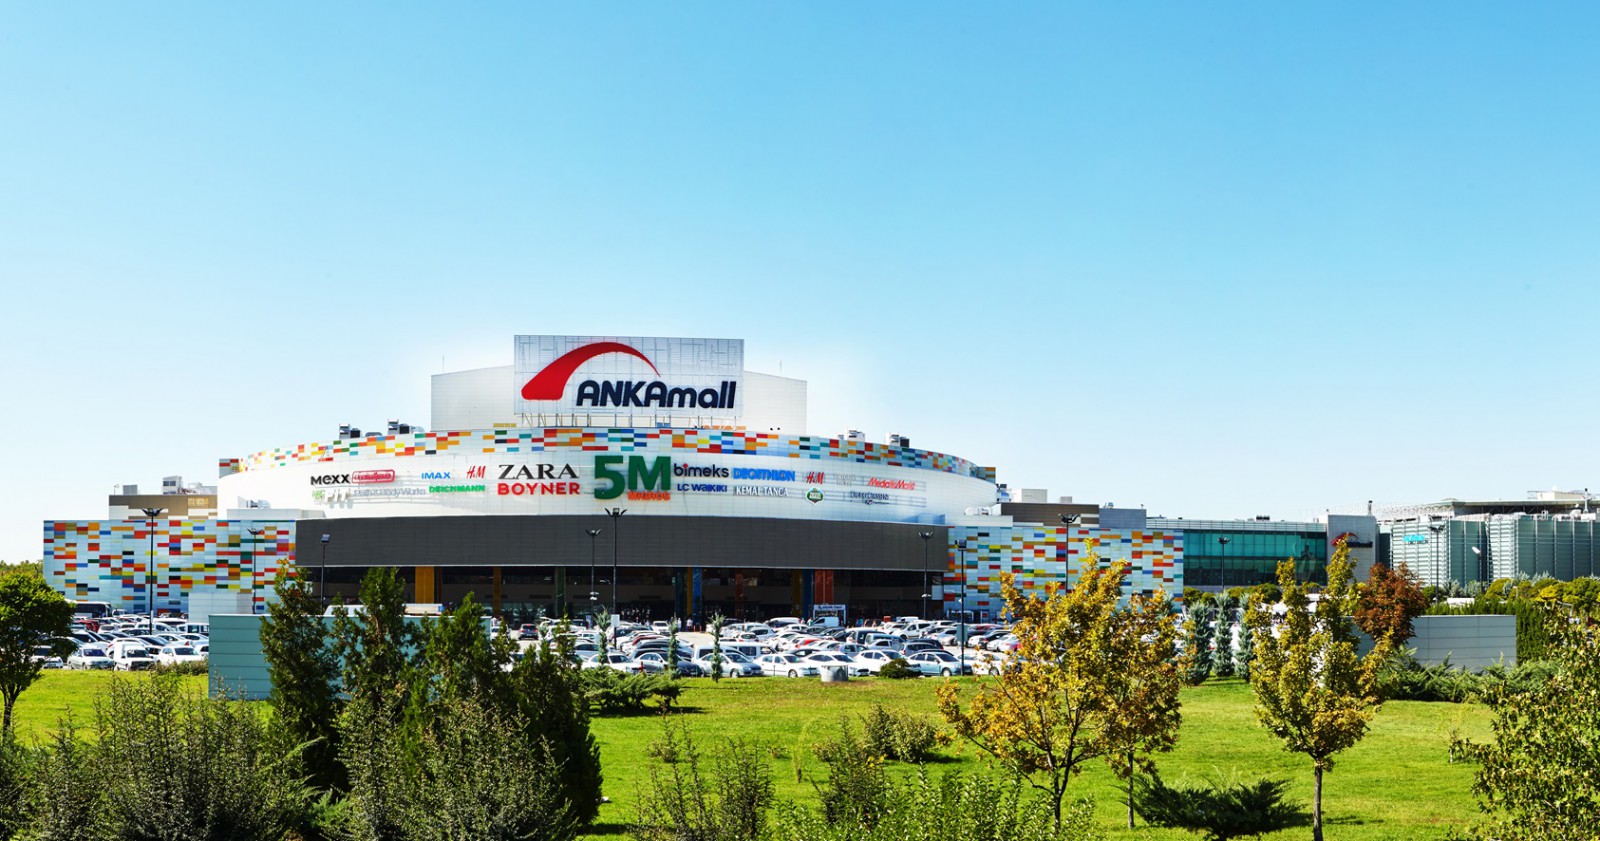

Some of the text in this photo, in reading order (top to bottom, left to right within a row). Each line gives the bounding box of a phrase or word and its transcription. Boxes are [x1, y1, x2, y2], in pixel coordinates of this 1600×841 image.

[576, 380, 737, 408] ANKAmall
[498, 463, 579, 479] ZARA
[594, 455, 671, 499] 5M
[674, 463, 729, 478] bimeks
[733, 468, 795, 481] DECATHLON
[429, 485, 486, 493] DEICHMANN
[498, 482, 580, 495] BOYNER
[677, 483, 689, 491] LC
[736, 486, 761, 496] KEMAL
[628, 491, 671, 501] MIGROS
